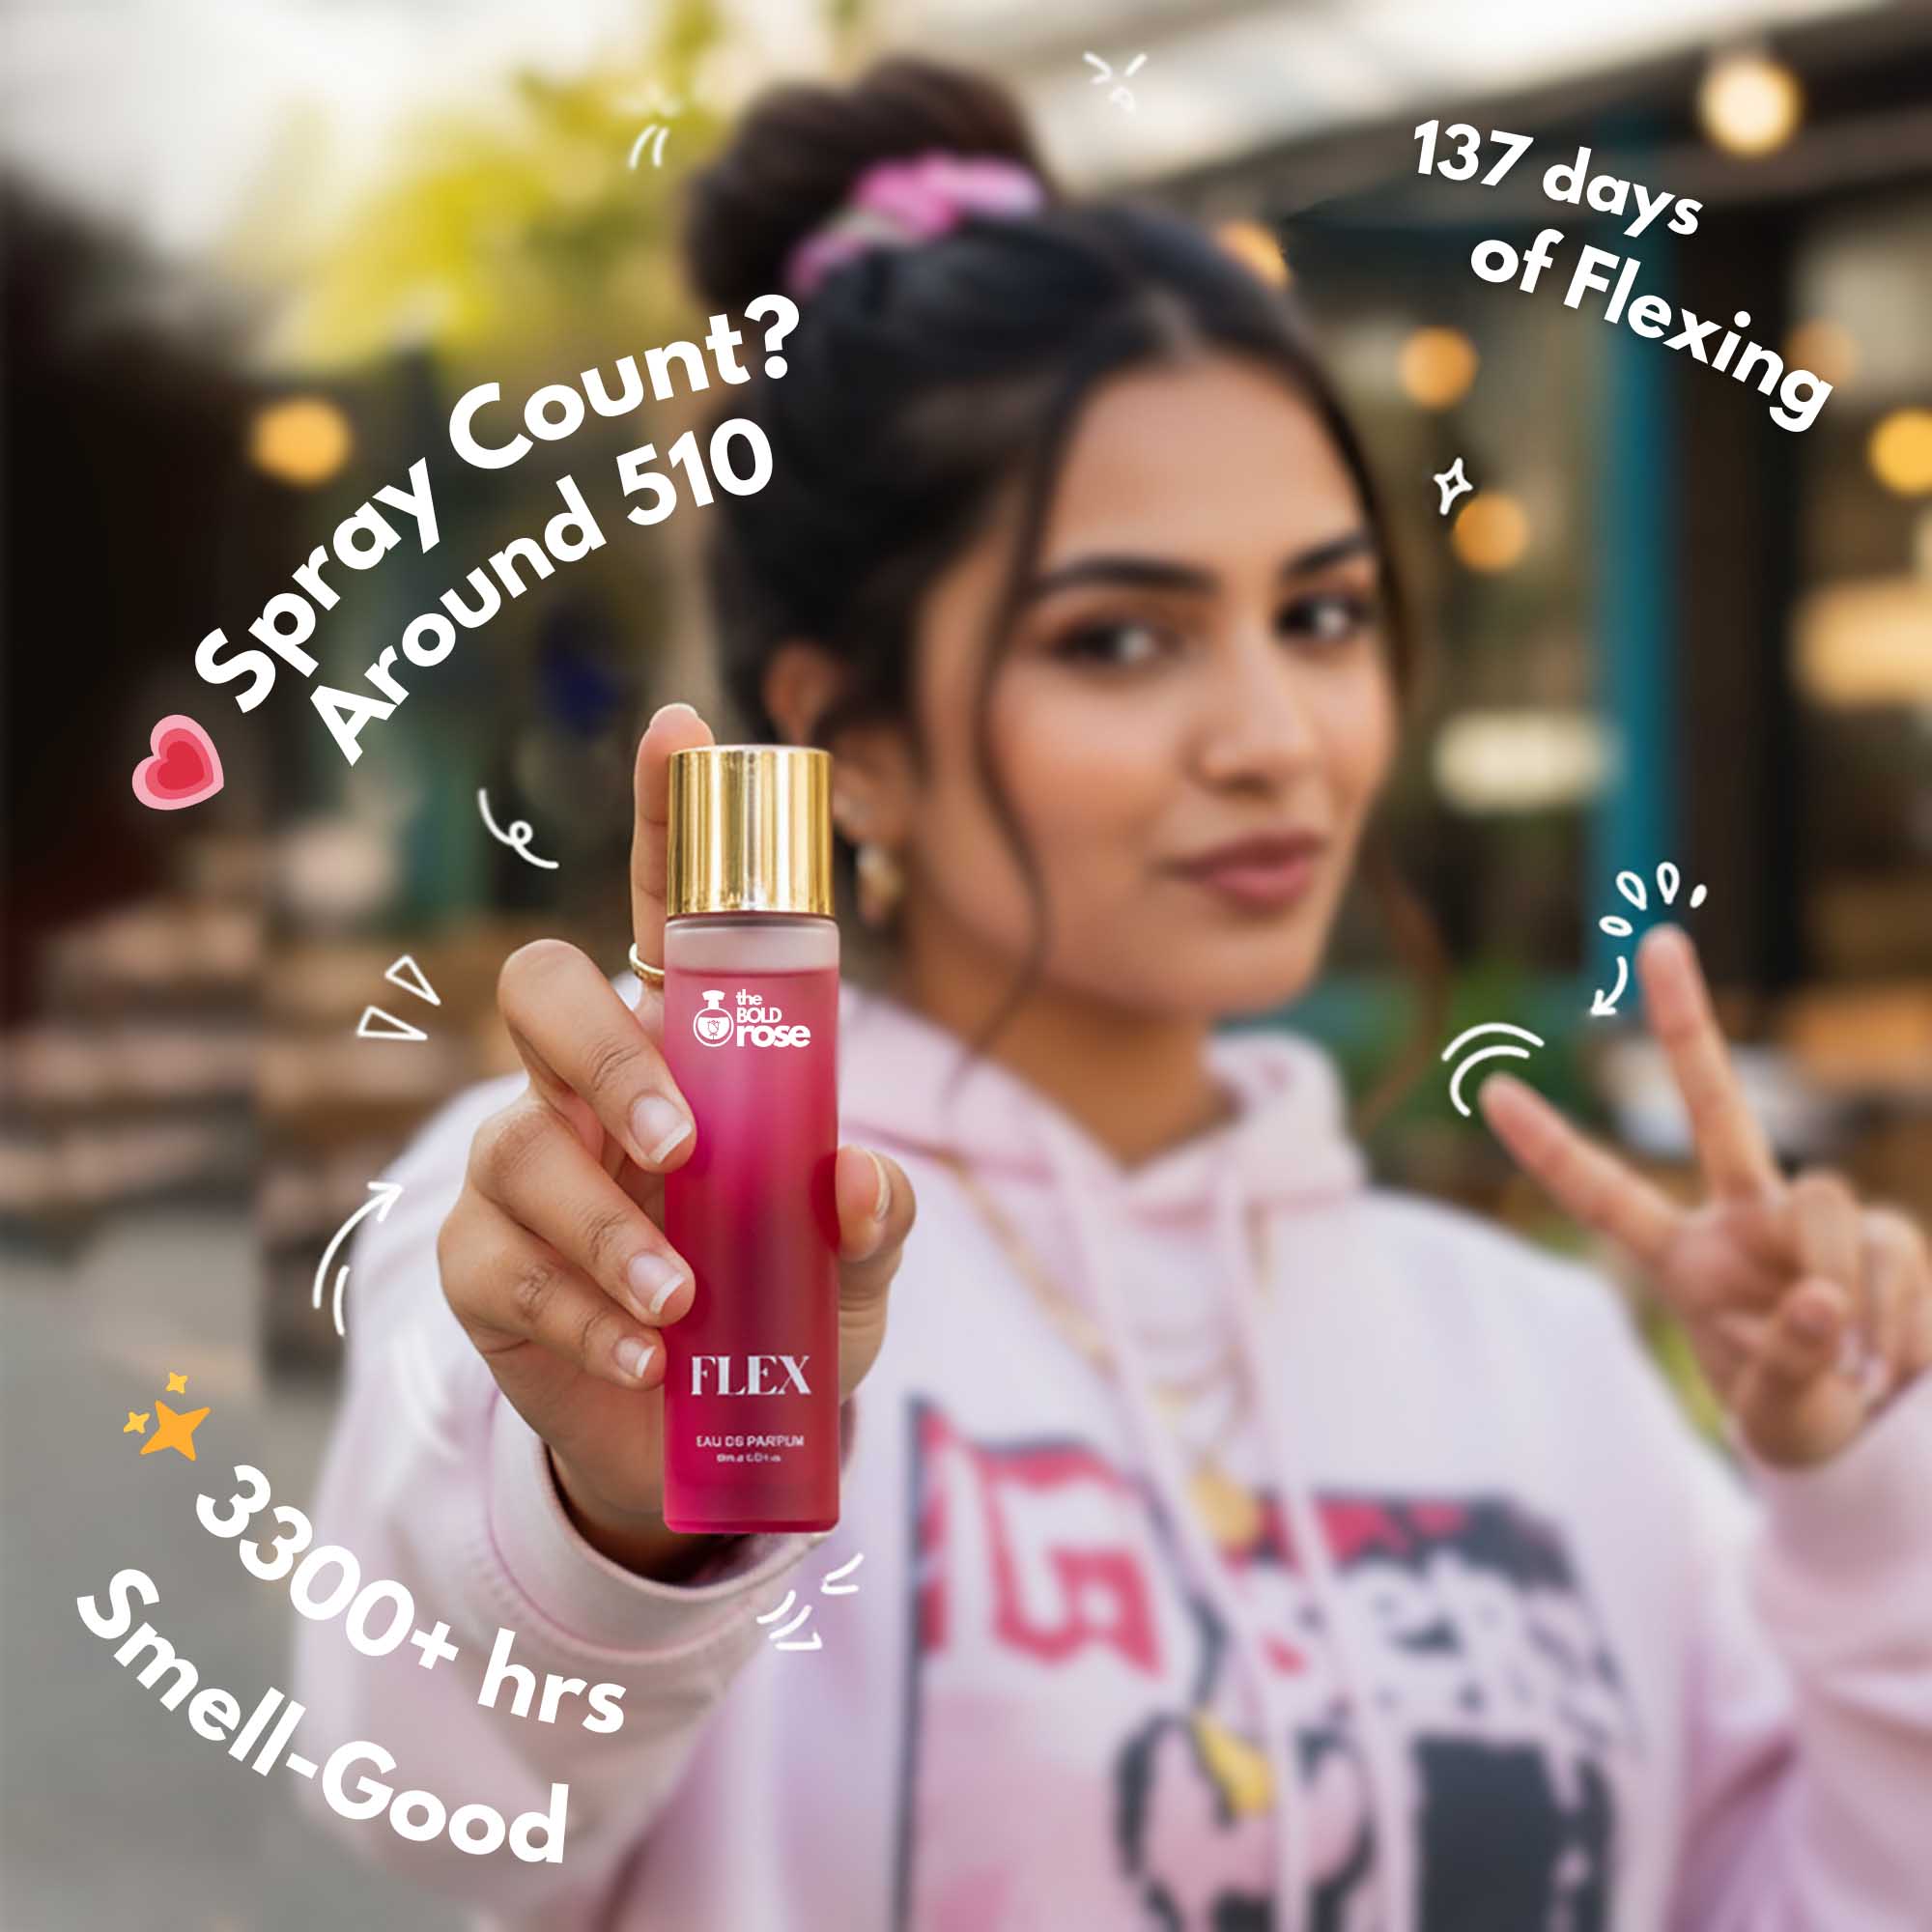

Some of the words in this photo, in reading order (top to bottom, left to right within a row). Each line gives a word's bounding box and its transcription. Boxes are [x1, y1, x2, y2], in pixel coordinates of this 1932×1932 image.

[735, 988, 763, 1006] the
[736, 1007, 782, 1024] BOLD
[736, 1024, 811, 1048] rose
[691, 1354, 812, 1396] FLEX
[696, 1435, 722, 1447] EAU
